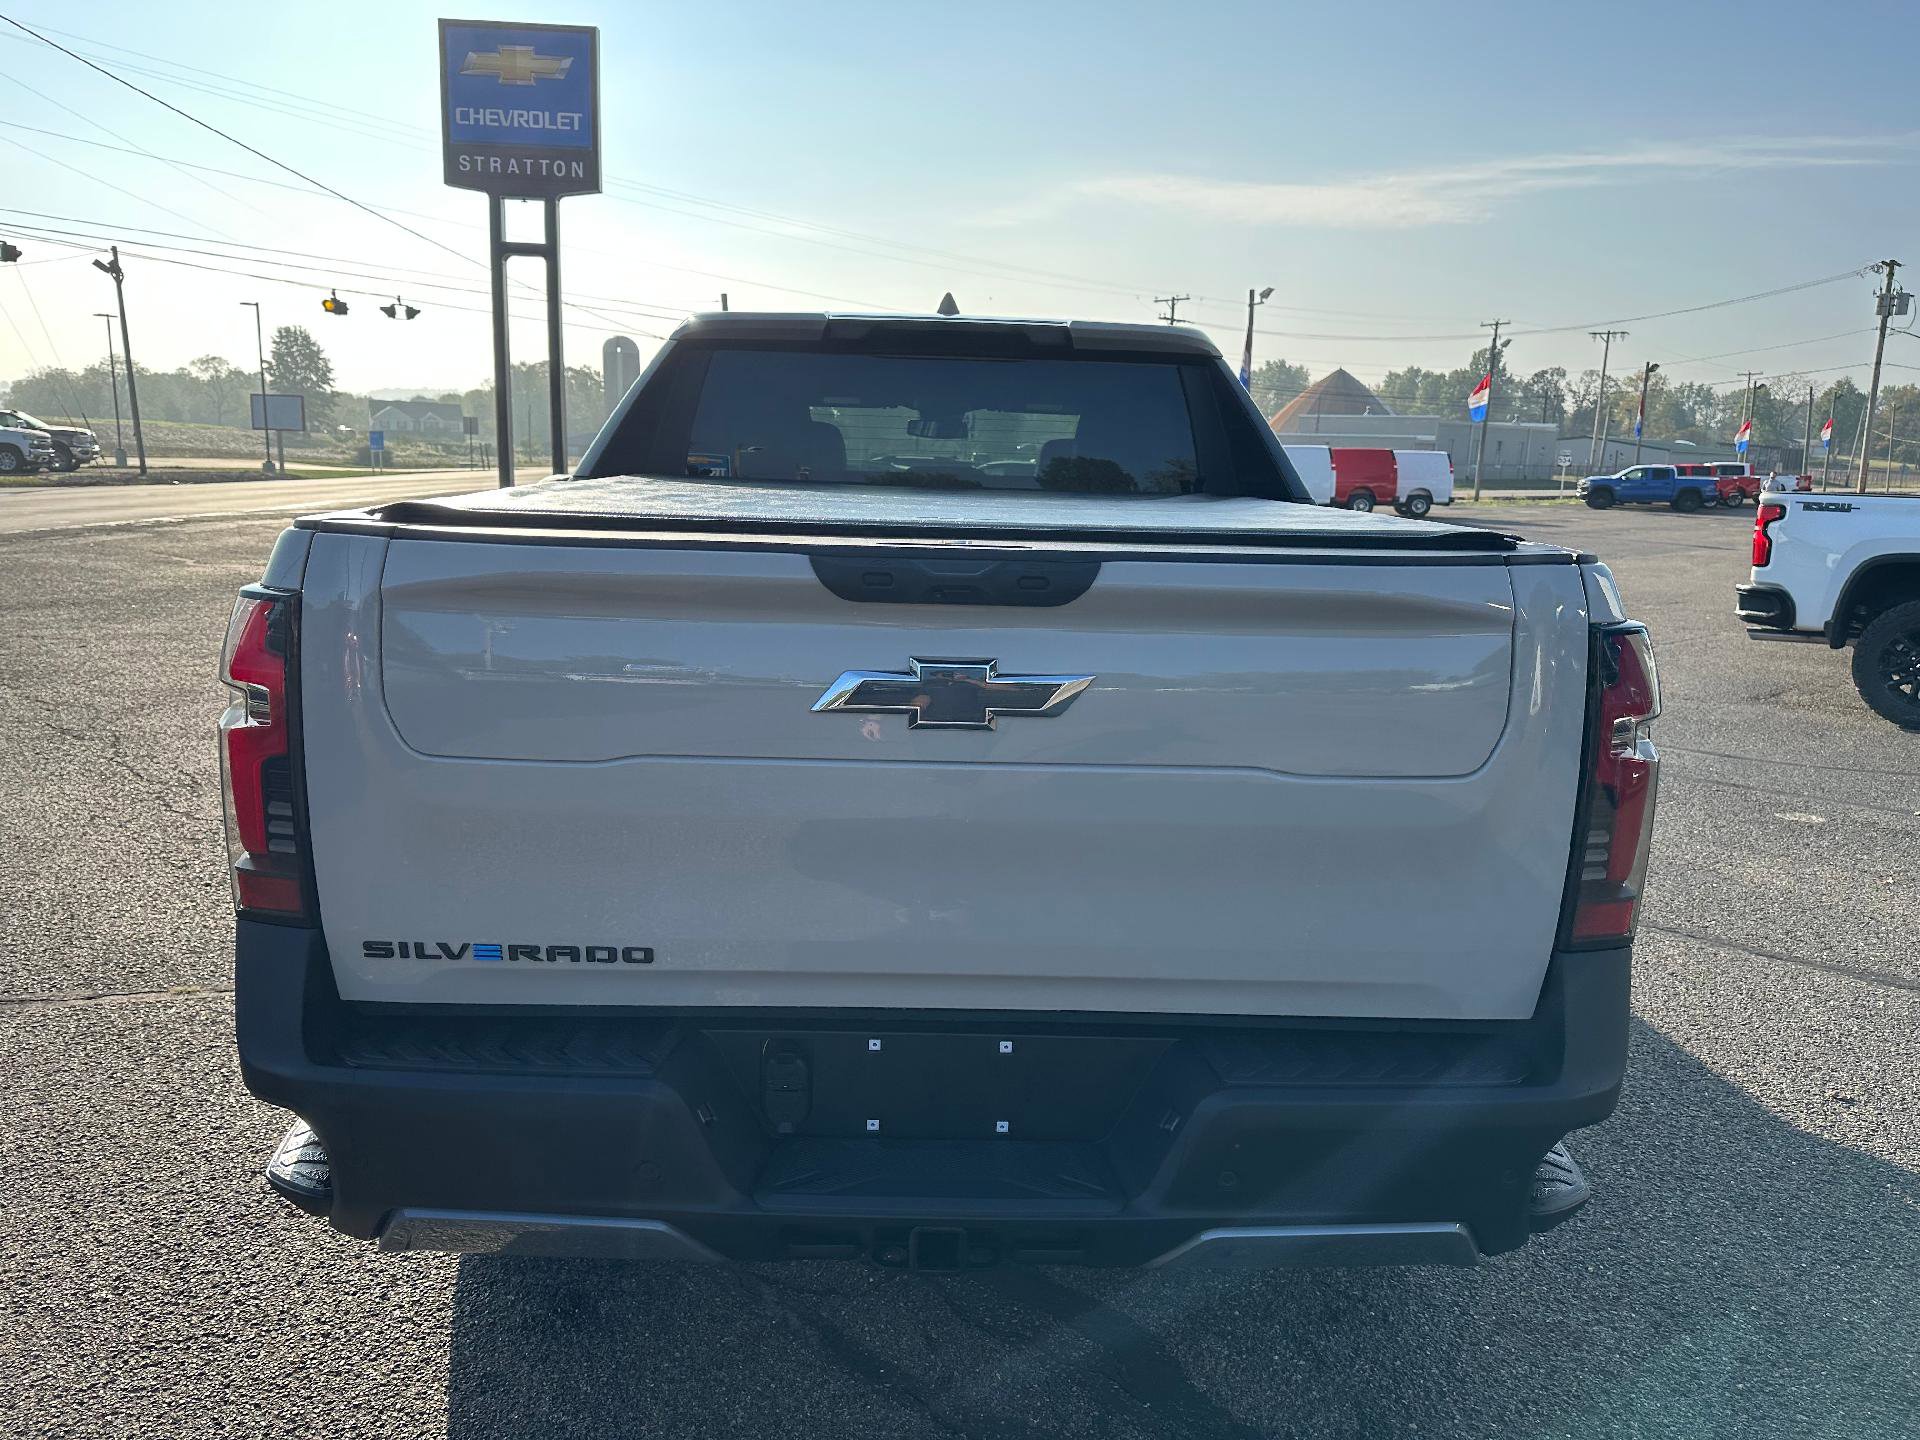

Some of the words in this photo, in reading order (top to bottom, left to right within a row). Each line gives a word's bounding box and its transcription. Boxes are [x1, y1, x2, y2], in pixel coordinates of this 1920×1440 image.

[455, 107, 583, 131] CHEVROLET
[459, 154, 584, 178] STRATTON
[362, 940, 655, 964] SILVERADO
